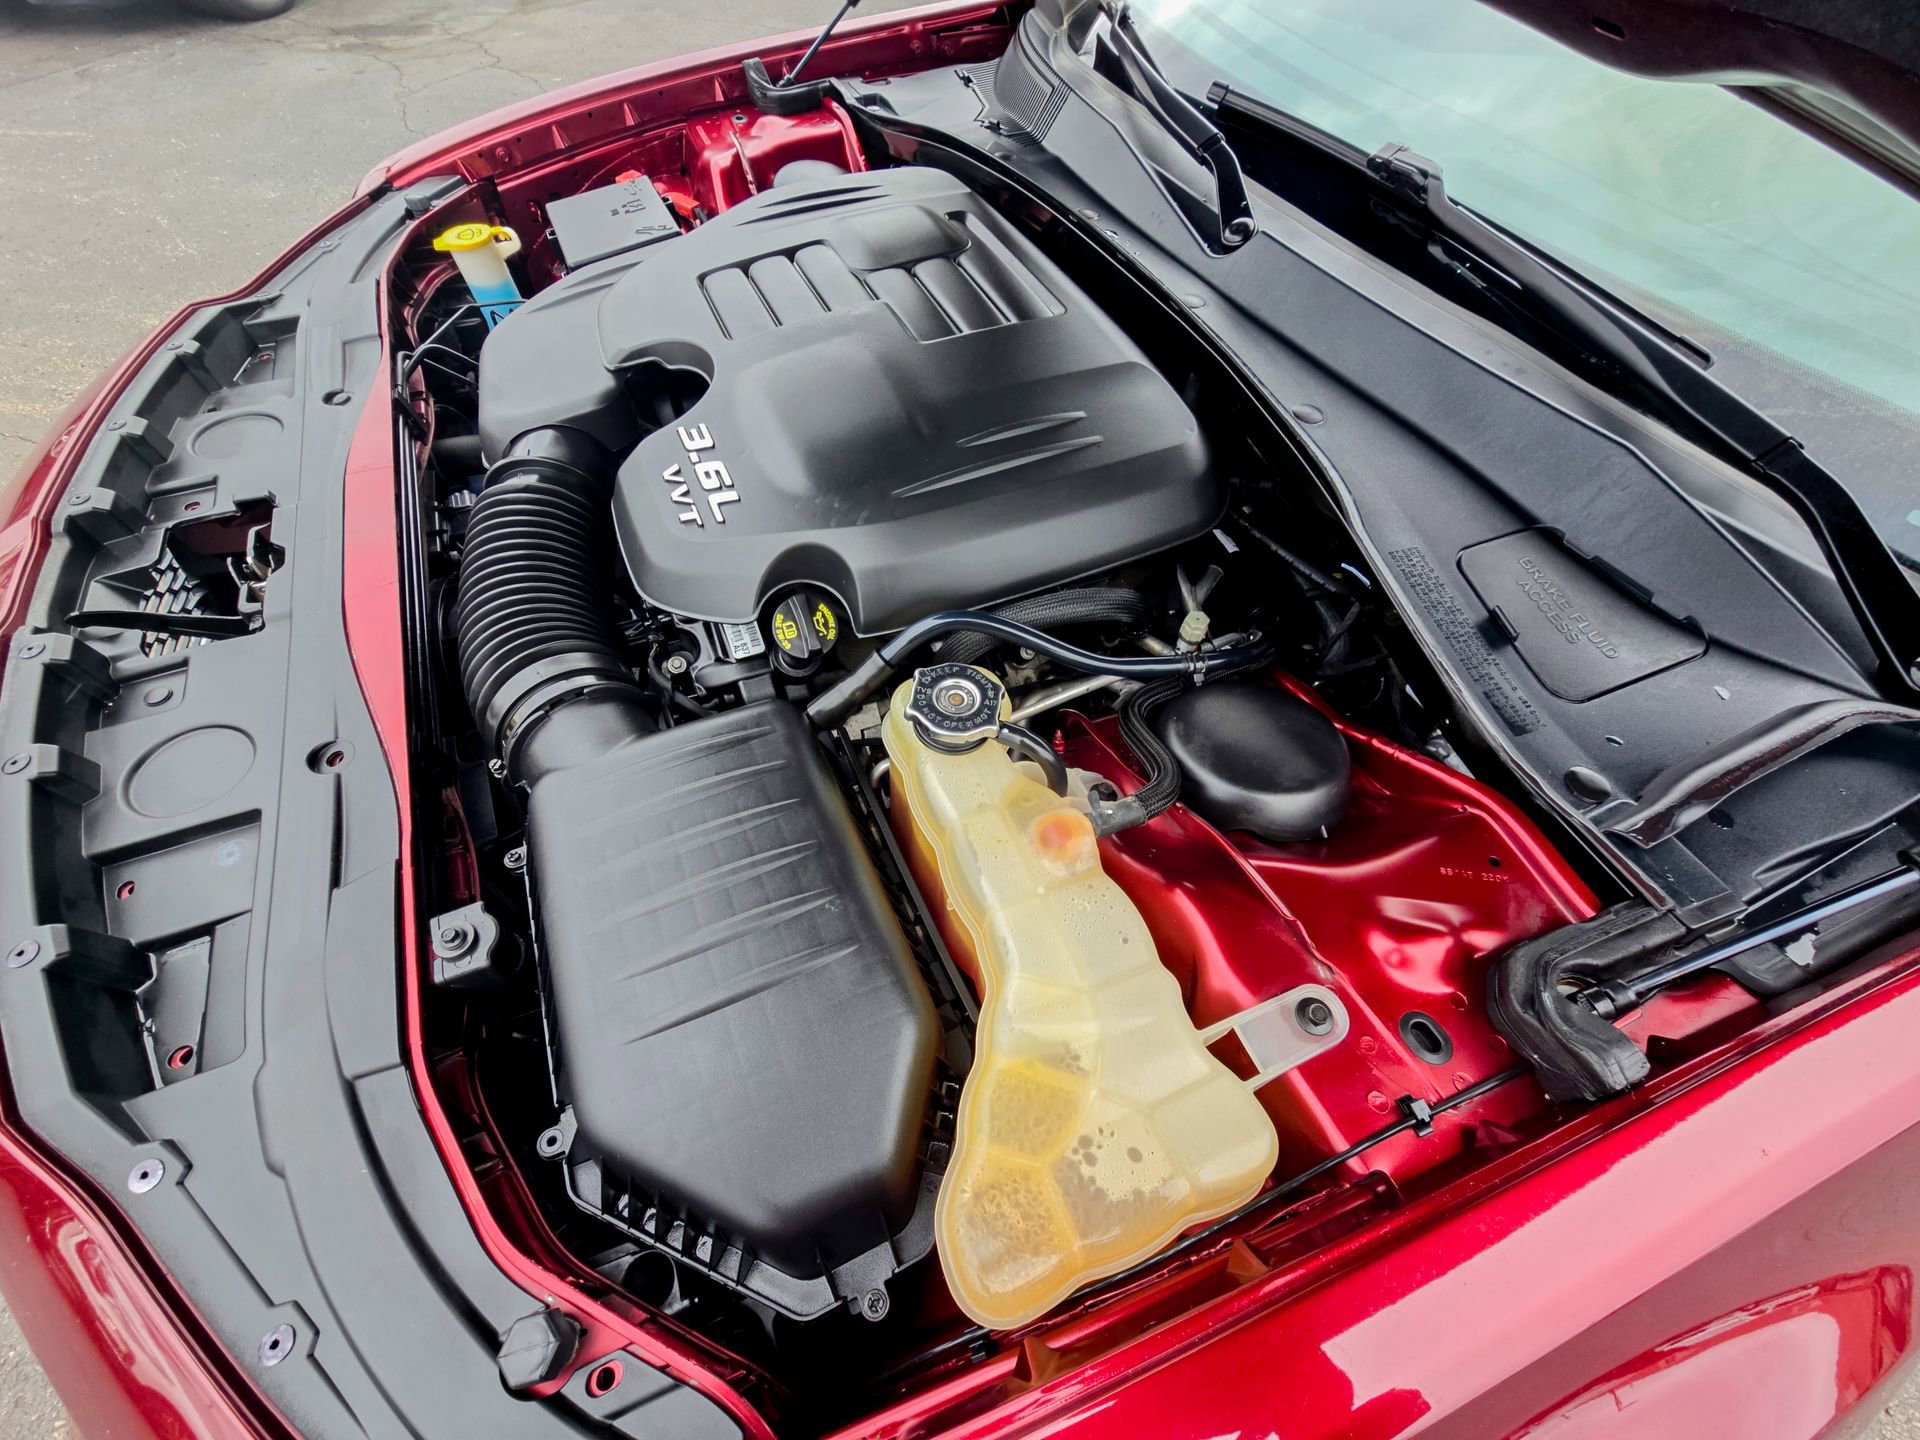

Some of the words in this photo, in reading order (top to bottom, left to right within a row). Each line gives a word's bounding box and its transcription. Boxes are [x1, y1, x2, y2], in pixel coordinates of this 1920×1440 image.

[677, 423, 741, 524] 3.6L
[662, 463, 704, 528] VVT
[775, 613, 784, 628] SAE
[818, 603, 836, 628] ENGINE
[827, 629, 836, 640] OIL
[1516, 580, 1581, 644] ACCESS
[1519, 556, 1574, 611] BRAKE
[1569, 612, 1619, 659] FLUID
[916, 686, 933, 695] TVS
[931, 667, 960, 678] KEEP
[922, 708, 942, 723] NOT
